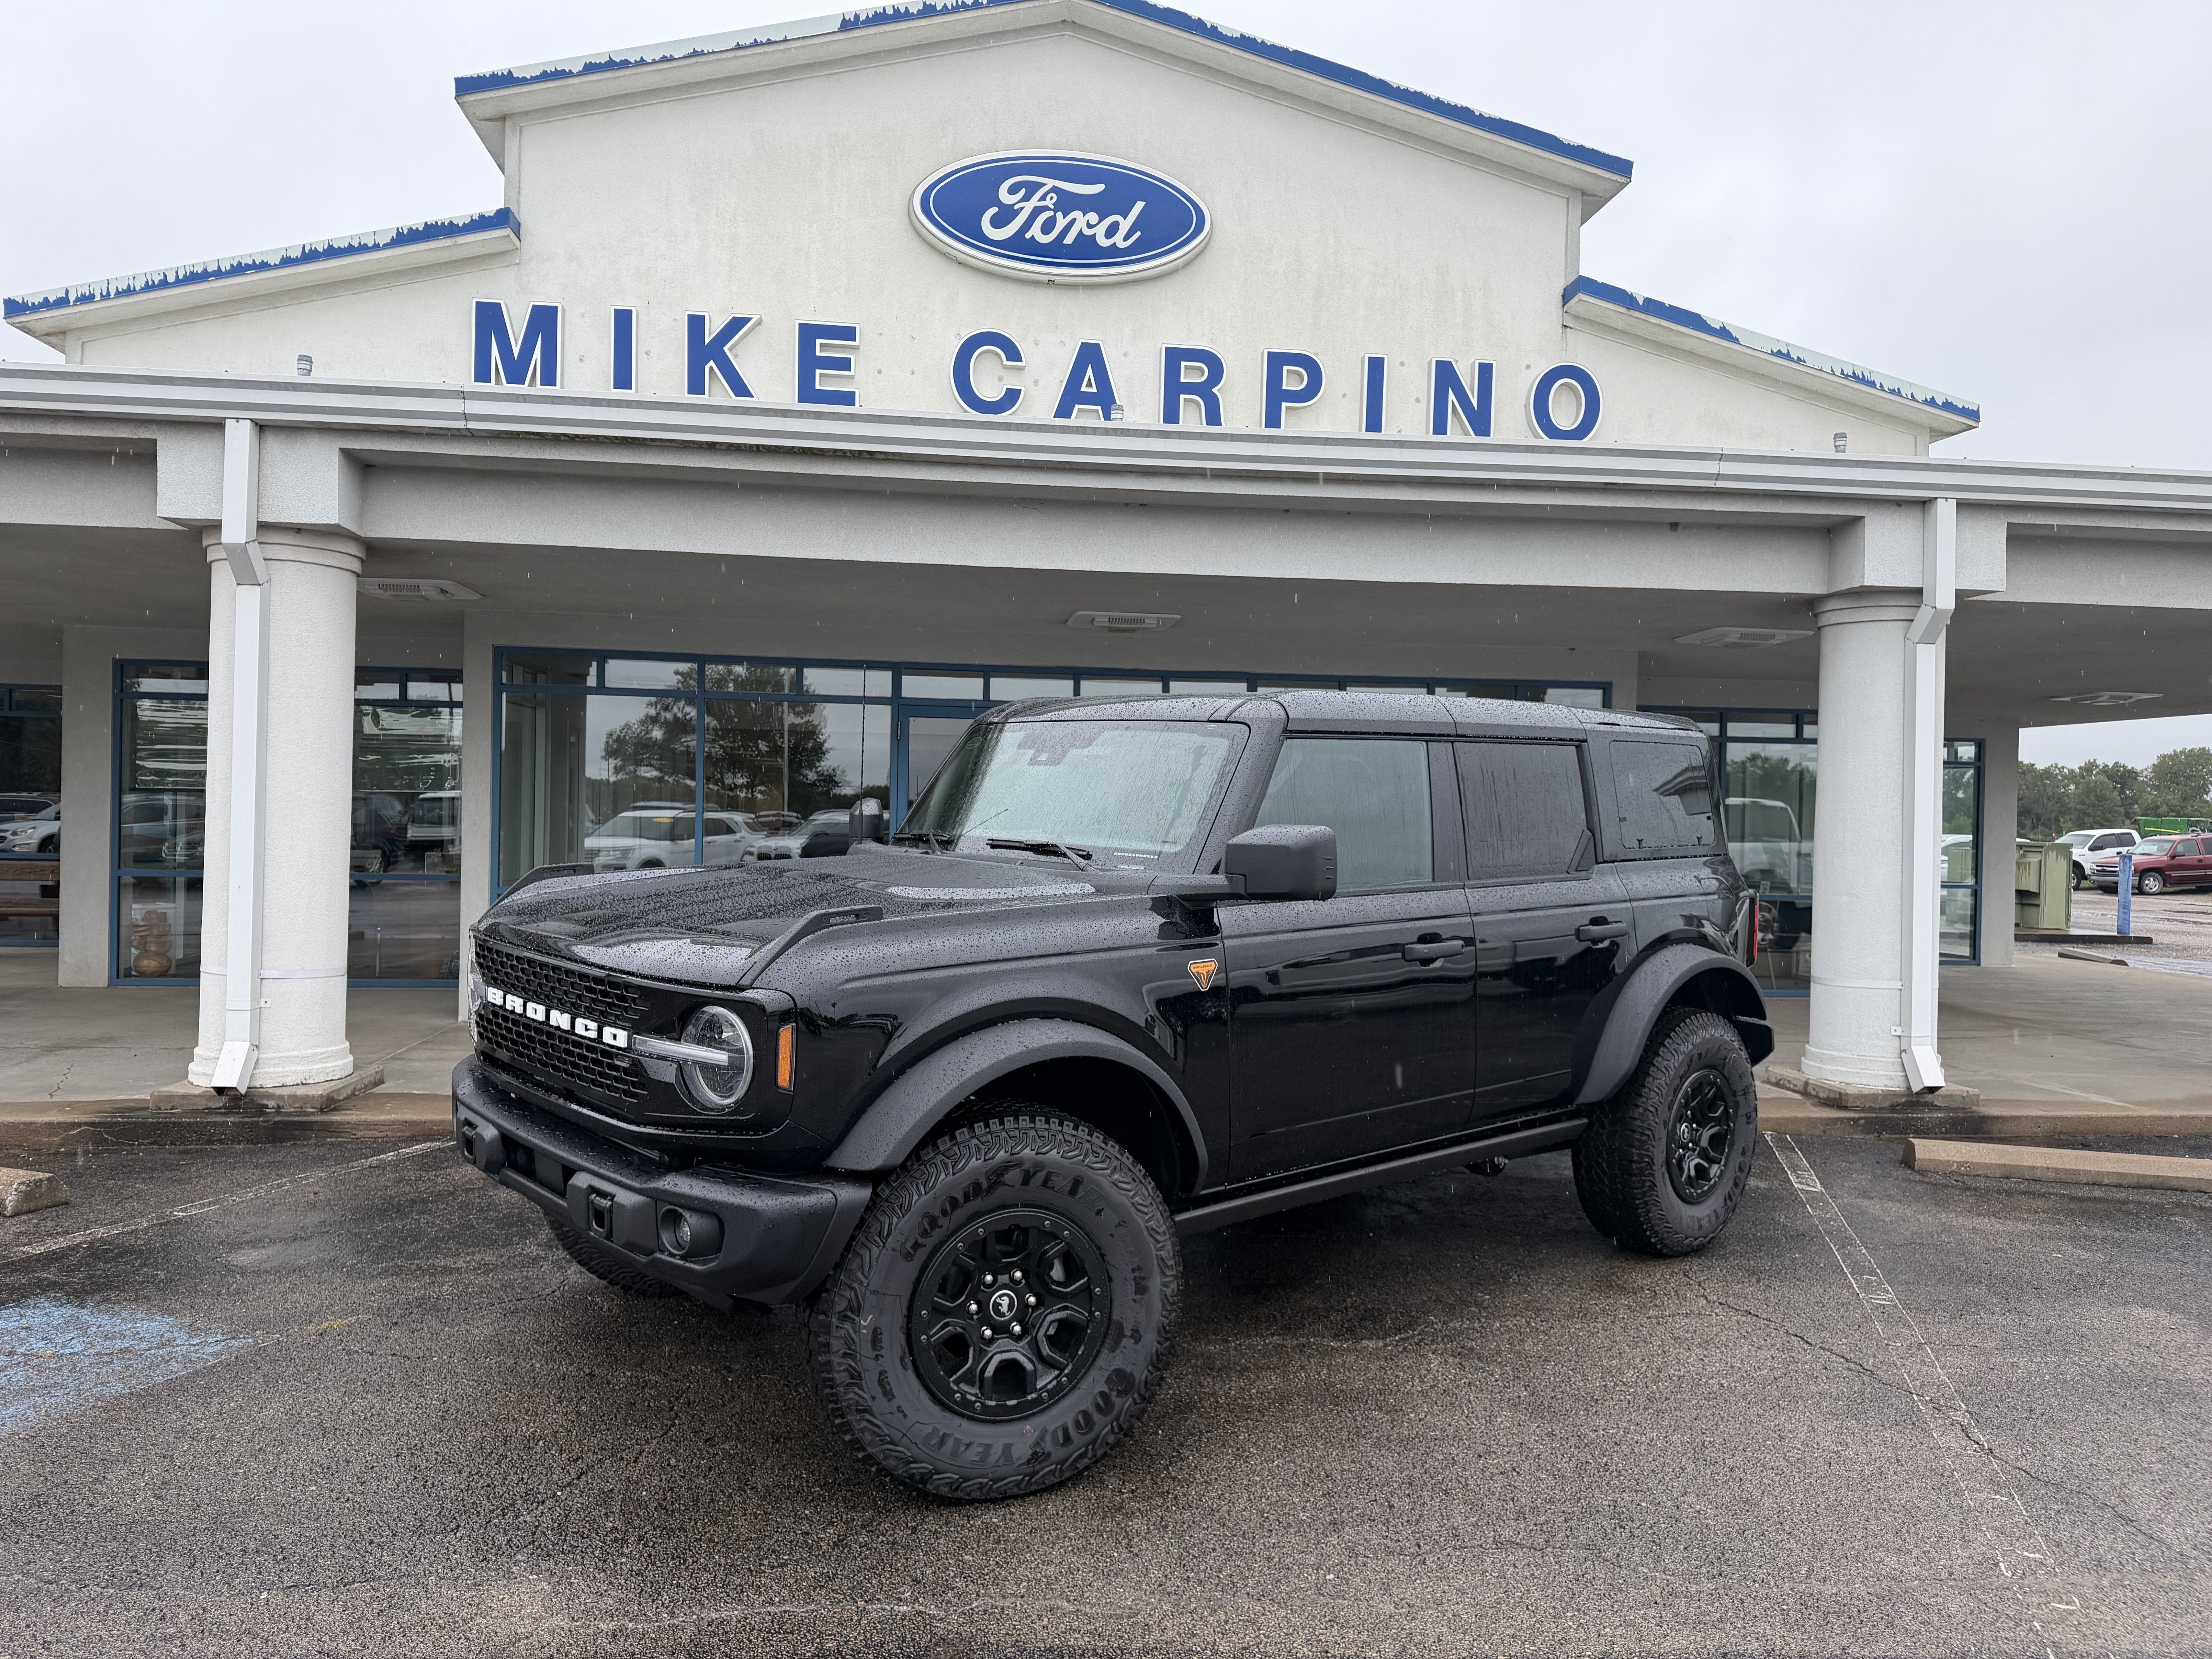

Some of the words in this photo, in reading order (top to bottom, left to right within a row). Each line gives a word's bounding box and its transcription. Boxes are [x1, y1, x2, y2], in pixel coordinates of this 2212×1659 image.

[981, 175, 1146, 249] Ford
[473, 301, 858, 407] MIKE
[952, 330, 1602, 441] CARPINO
[487, 986, 628, 1048] BRONCO
